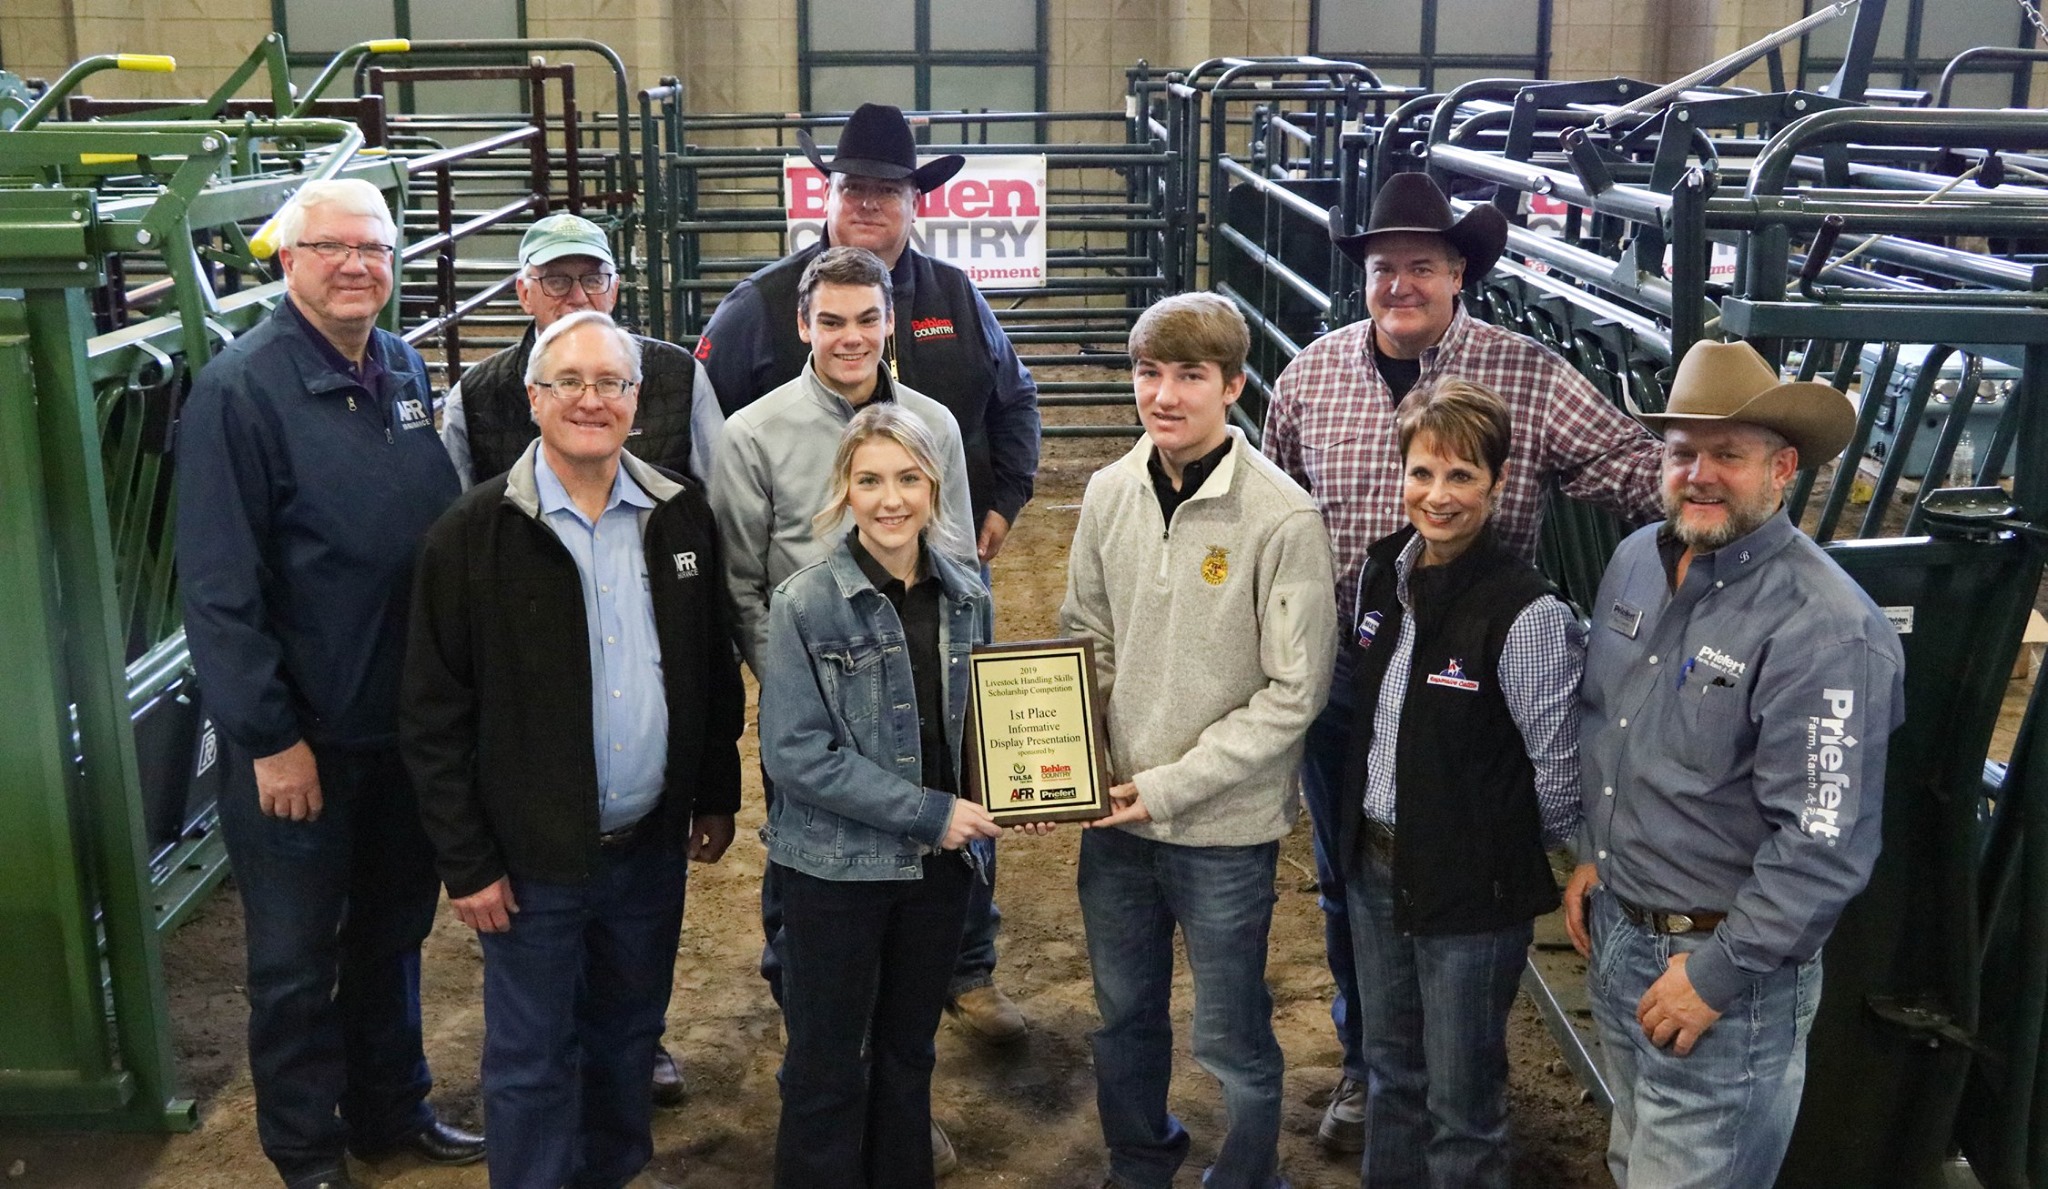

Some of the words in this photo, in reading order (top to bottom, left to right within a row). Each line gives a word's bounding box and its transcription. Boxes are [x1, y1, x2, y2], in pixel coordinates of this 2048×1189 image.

[786, 167, 1040, 218] Blen
[791, 220, 1040, 259] CNTRY
[966, 266, 1041, 282] ipment
[911, 317, 952, 331] Behlen
[914, 326, 954, 338] COUNTRY
[1698, 645, 1746, 674] Priefert
[1020, 667, 1038, 675] 2019
[985, 677, 1018, 688] Livestock
[1020, 675, 1053, 685] Handling
[1054, 674, 1074, 682] Skills
[988, 687, 1029, 697] Scholarship
[1030, 684, 1073, 695] Competition
[1010, 709, 1024, 720] 1st
[1028, 707, 1057, 719] Place
[1008, 723, 1060, 734] Informative
[1806, 716, 1819, 749] Farm,
[990, 738, 1024, 750] Display
[1027, 734, 1081, 746] Presentation
[1018, 748, 1047, 757] sponsored
[1047, 747, 1055, 755] by
[1040, 764, 1072, 774] Behlen
[1809, 688, 1858, 838] Priefert
[1008, 774, 1033, 782] TULSA
[1041, 771, 1072, 780] COUNTRY
[1807, 753, 1818, 789] Ranch
[1010, 787, 1035, 801] AFR
[1041, 788, 1075, 799] Priefert
